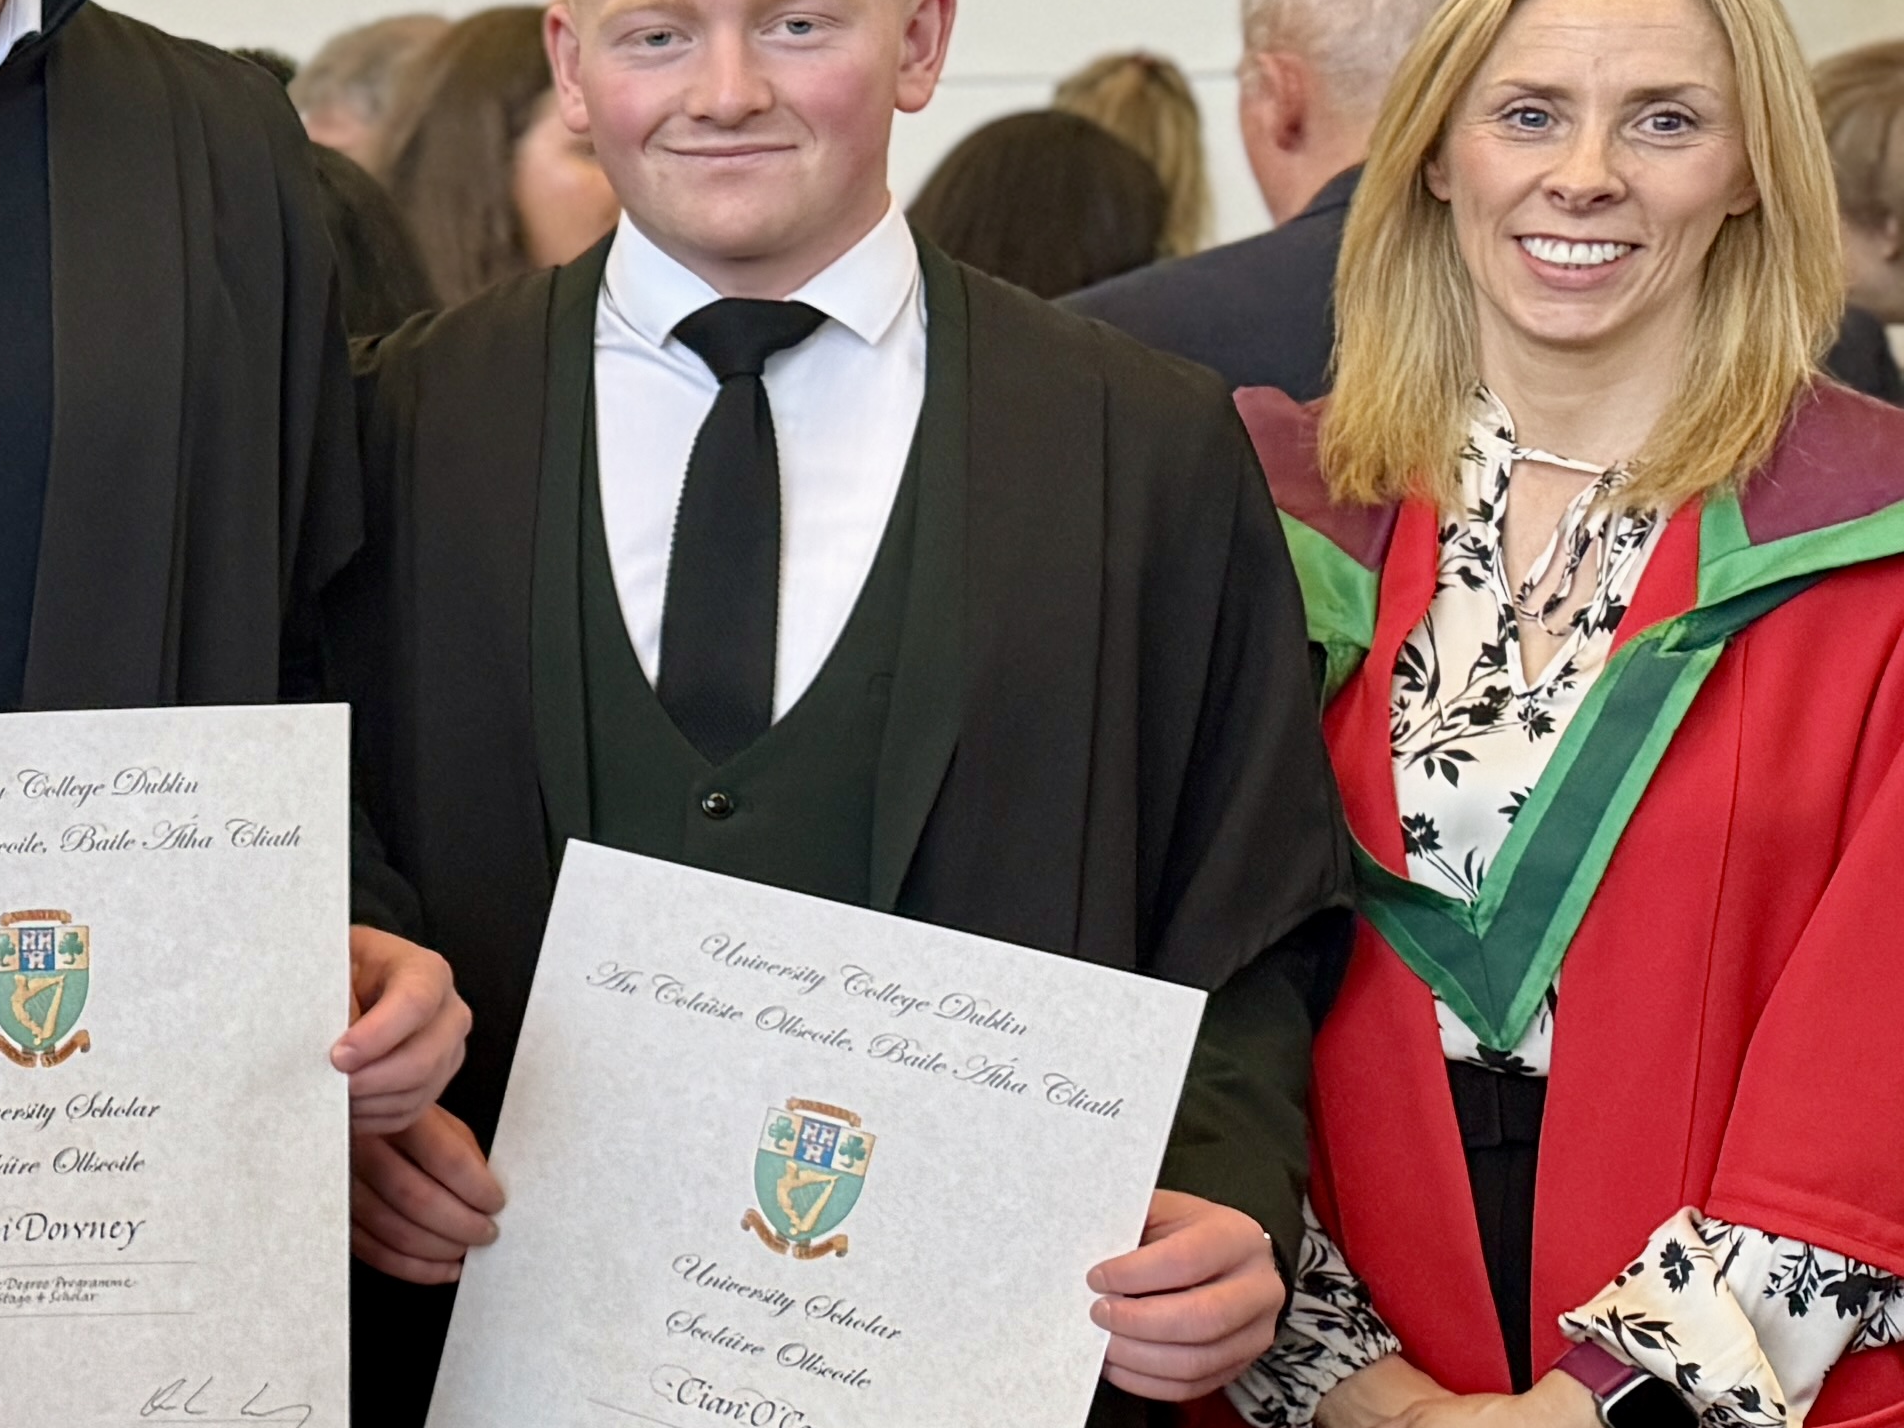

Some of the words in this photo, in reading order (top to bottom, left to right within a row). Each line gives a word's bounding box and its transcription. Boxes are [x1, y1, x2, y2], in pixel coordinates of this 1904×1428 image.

[17, 769, 105, 807] College
[112, 767, 198, 796] Dublin
[60, 823, 135, 854] Baile
[225, 817, 301, 848] Cliath
[700, 932, 827, 996] University
[841, 964, 930, 1018] College
[933, 992, 1027, 1035] Dublin
[586, 961, 643, 996] An
[867, 1032, 947, 1074] Baile
[1043, 1072, 1124, 1120] Cliath
[66, 1091, 160, 1121] Scholar
[16, 1212, 146, 1251] Downey
[672, 1253, 796, 1318] University
[805, 1294, 901, 1341] Scholar
[676, 1377, 749, 1421] Cian
